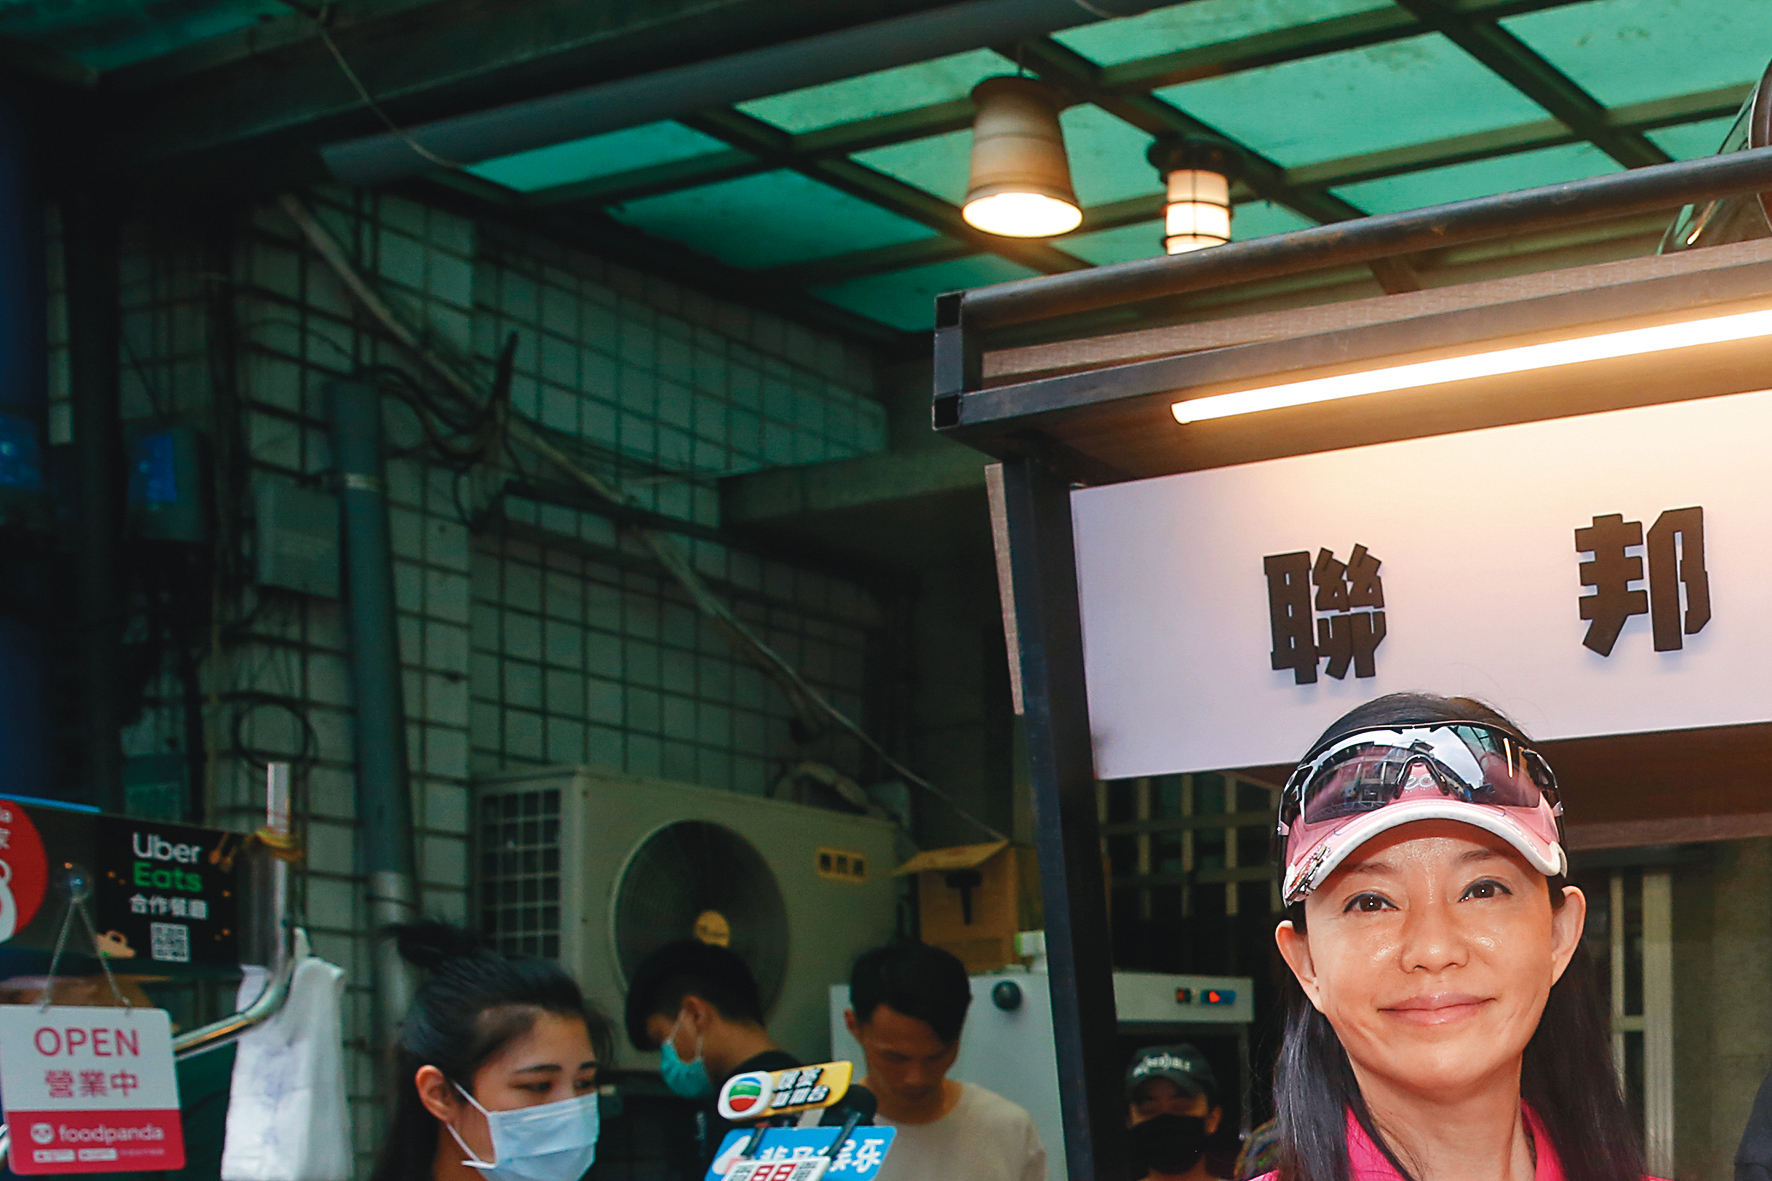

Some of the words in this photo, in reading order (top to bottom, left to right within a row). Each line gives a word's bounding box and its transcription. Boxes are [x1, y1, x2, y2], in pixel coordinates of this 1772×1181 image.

[133, 832, 202, 864] Uber
[133, 861, 203, 892] Eats
[34, 1027, 140, 1057] OPEN
[45, 1070, 138, 1098] 營業中
[59, 1123, 165, 1145] foodpanda
